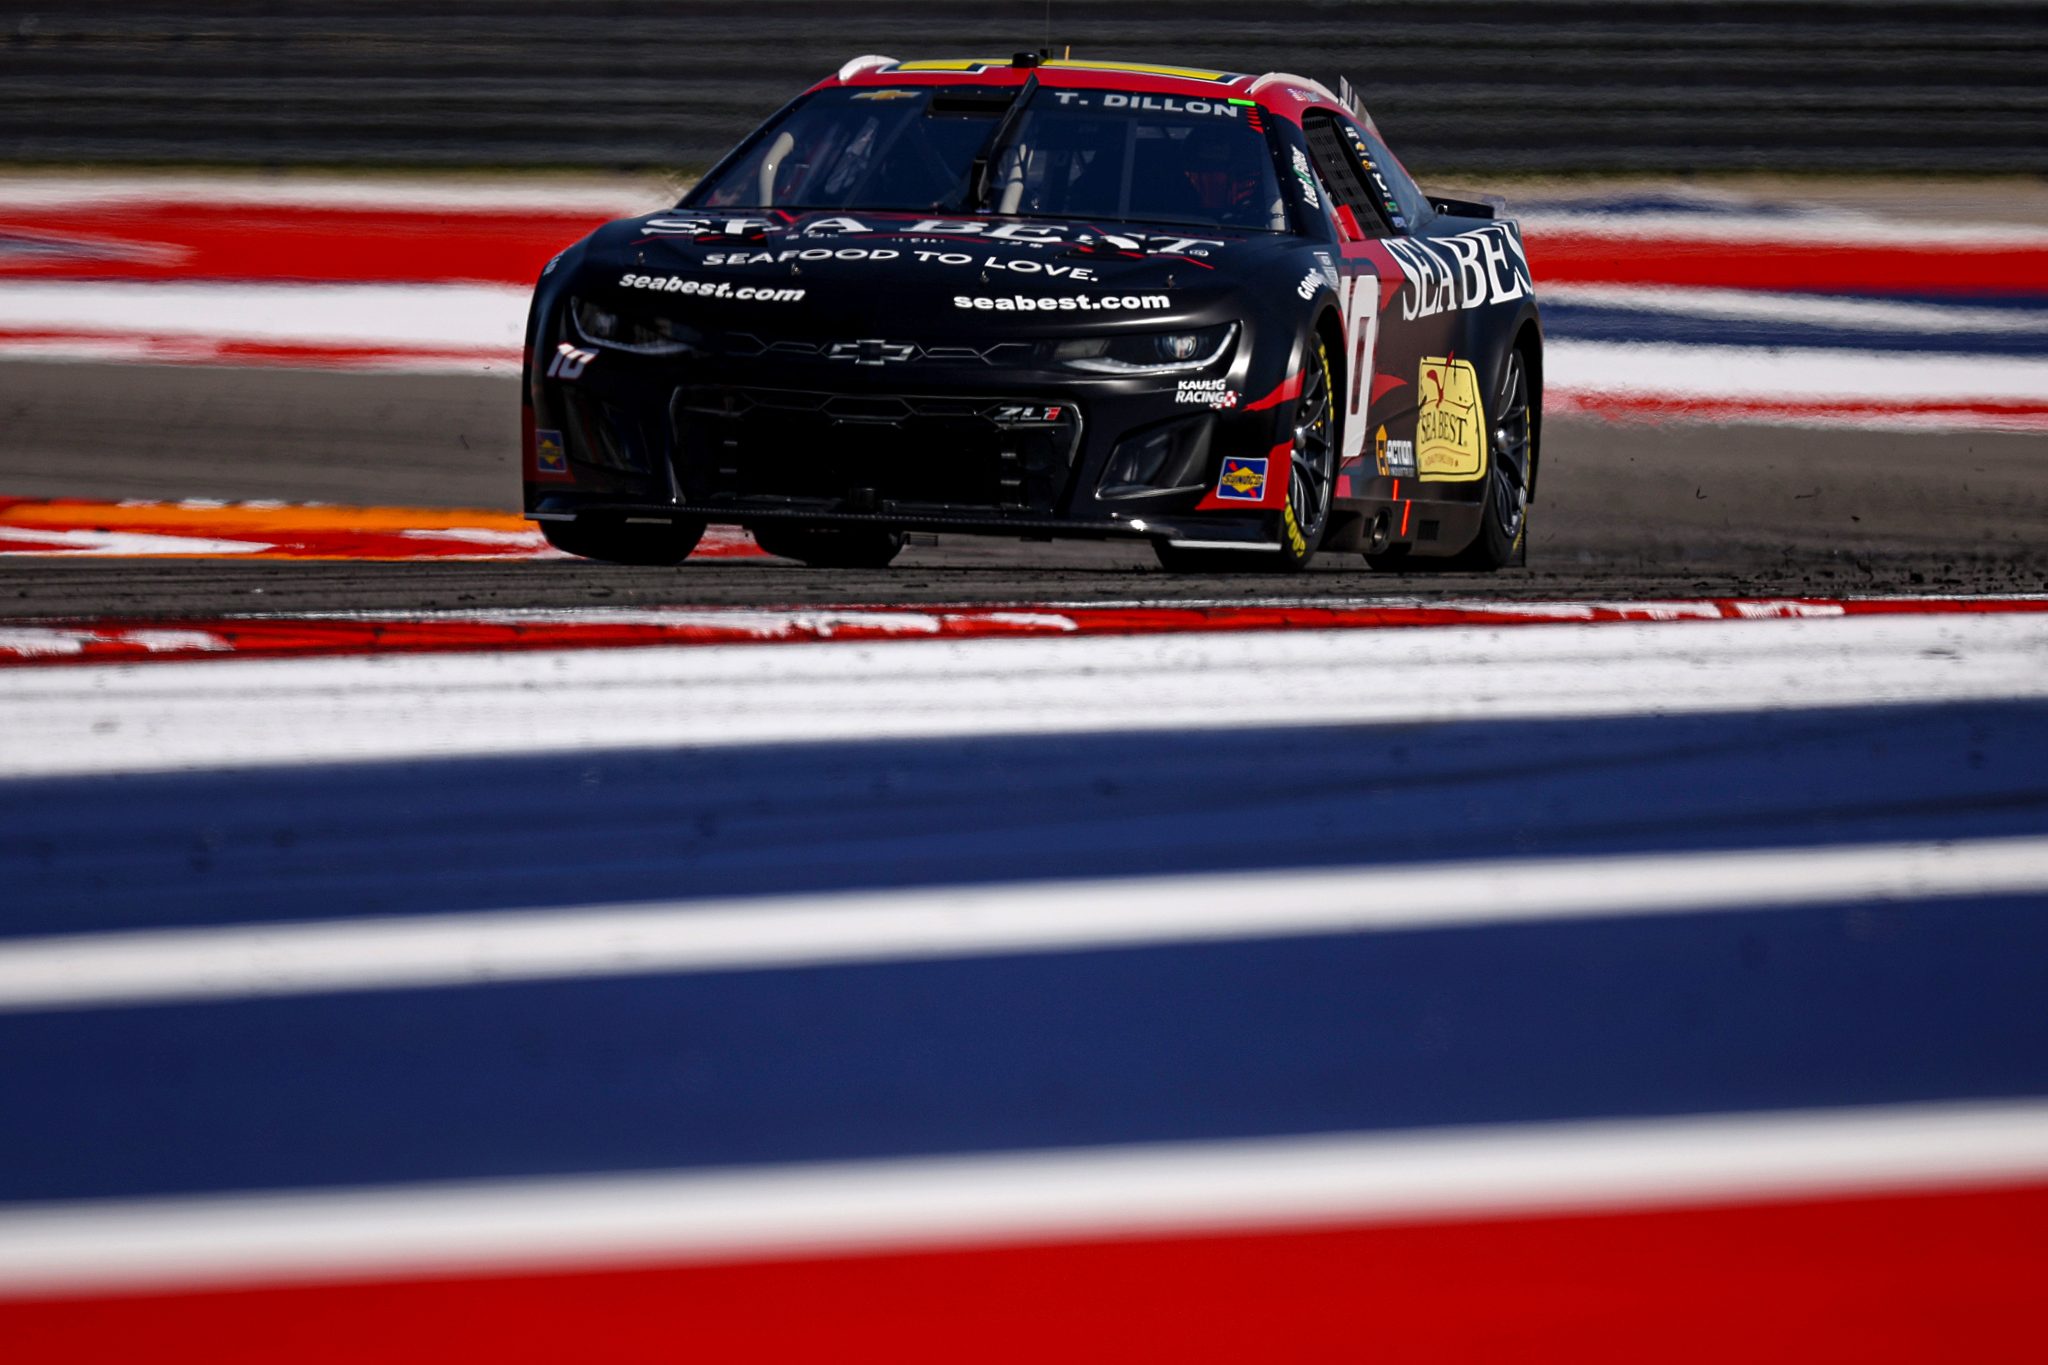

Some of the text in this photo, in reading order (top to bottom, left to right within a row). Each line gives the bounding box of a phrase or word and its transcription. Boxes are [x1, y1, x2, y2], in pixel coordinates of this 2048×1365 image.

[1055, 92, 1238, 117] T. DILLON
[702, 248, 1099, 282] SEAFOOD TO LOVE.
[619, 272, 806, 302] seabest.com
[1380, 237, 1457, 321] SEA
[953, 293, 1171, 311] seabest.com
[547, 343, 600, 379] 10
[1175, 390, 1224, 404] RACING
[1177, 379, 1226, 391] KAULIG
